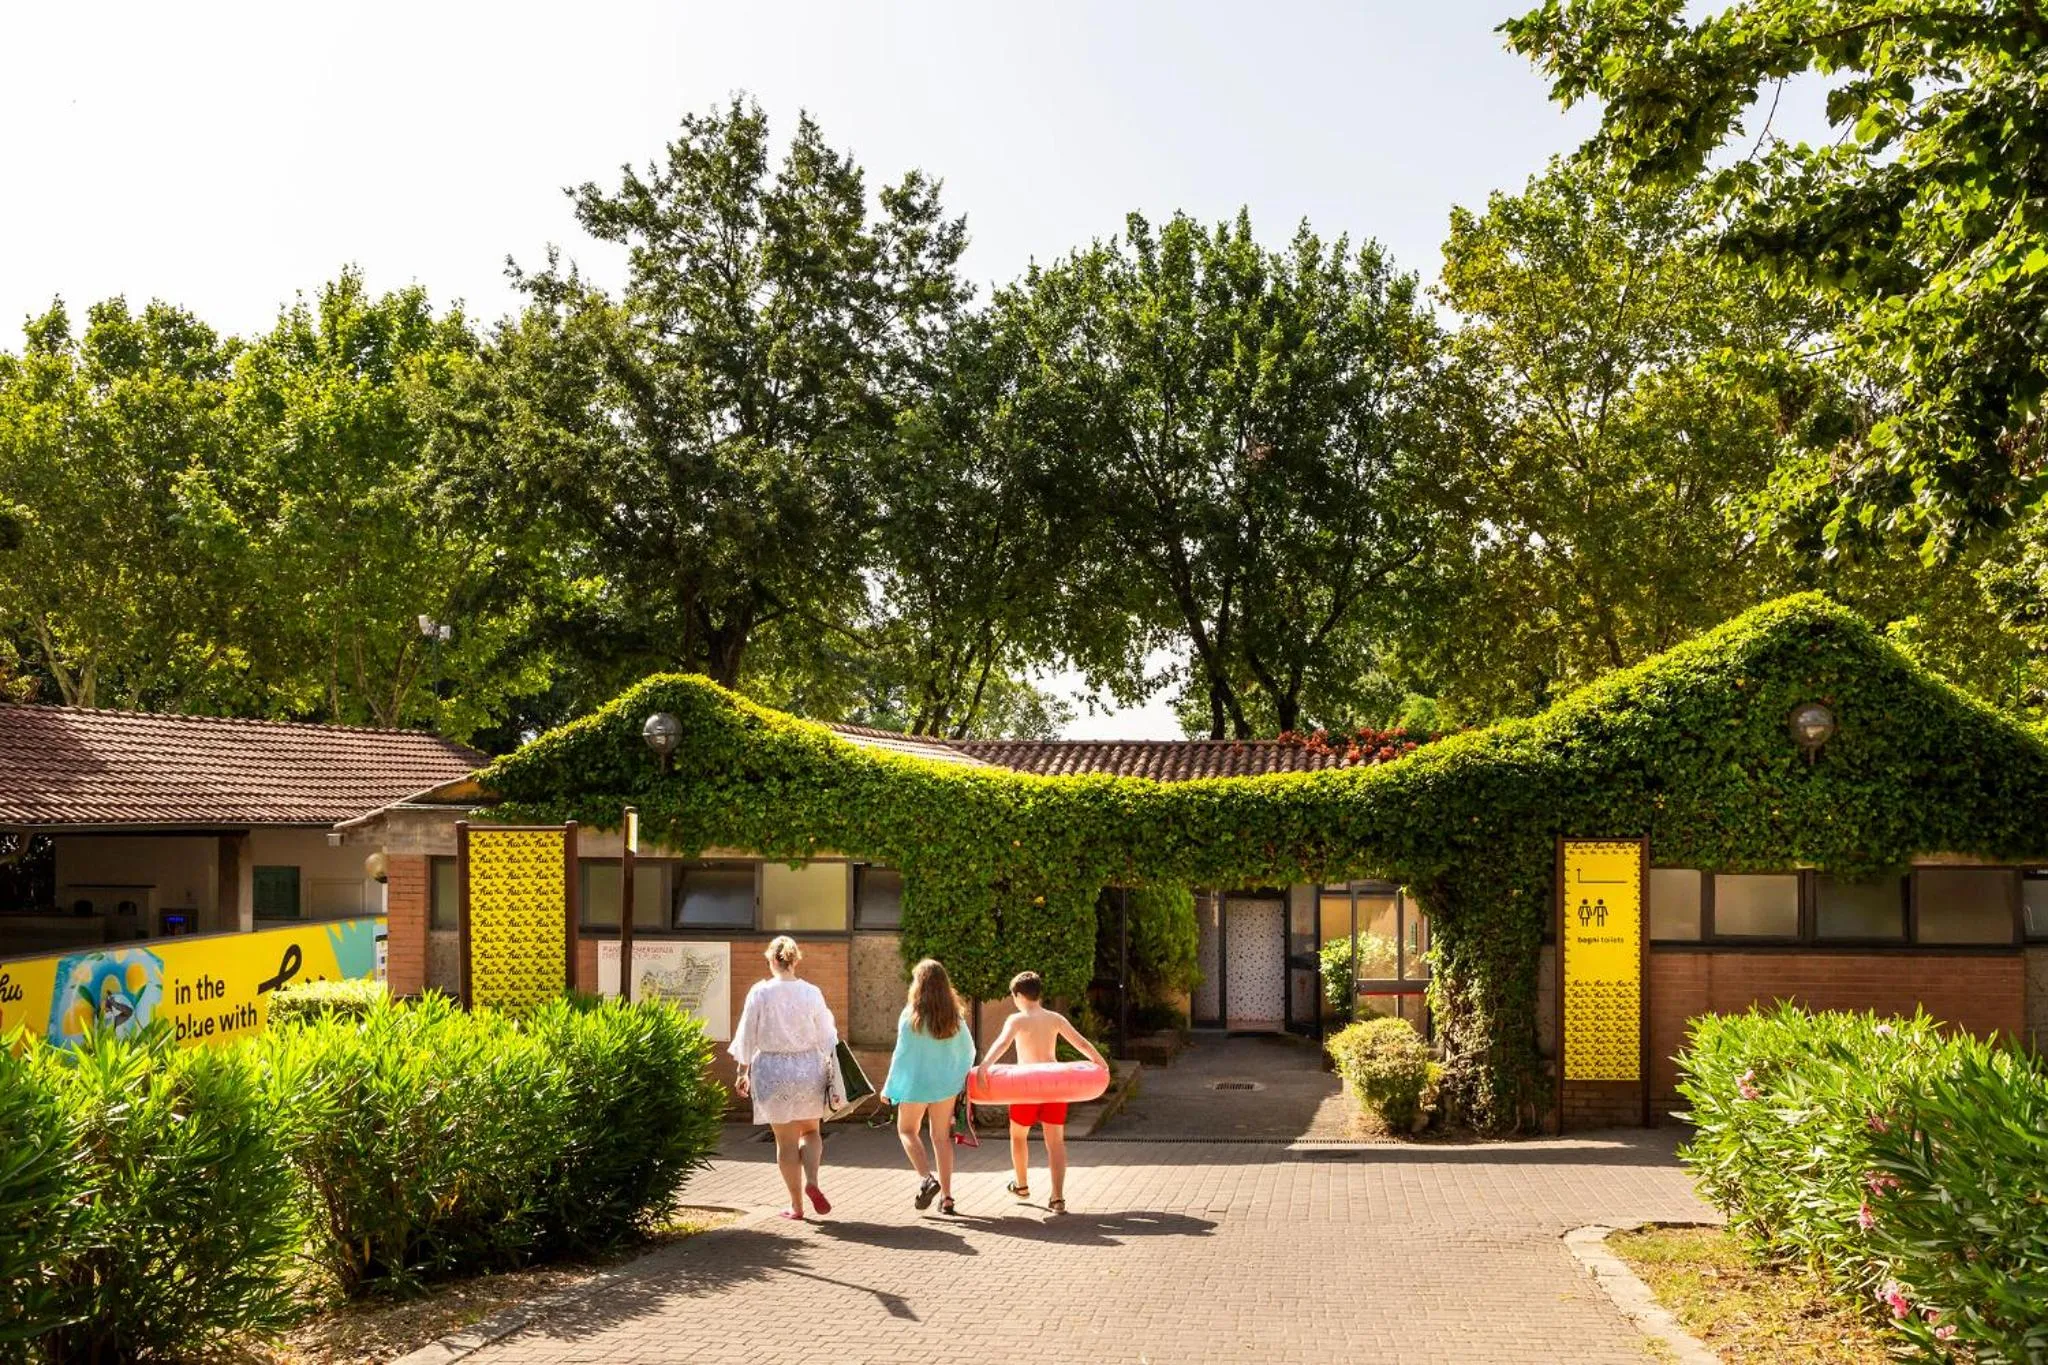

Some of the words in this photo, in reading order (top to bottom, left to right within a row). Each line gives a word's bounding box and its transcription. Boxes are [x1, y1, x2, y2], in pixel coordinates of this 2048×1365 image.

[175, 978, 191, 1005] in
[196, 974, 225, 1001] the
[175, 1013, 214, 1041] blue
[219, 1002, 257, 1032] with
